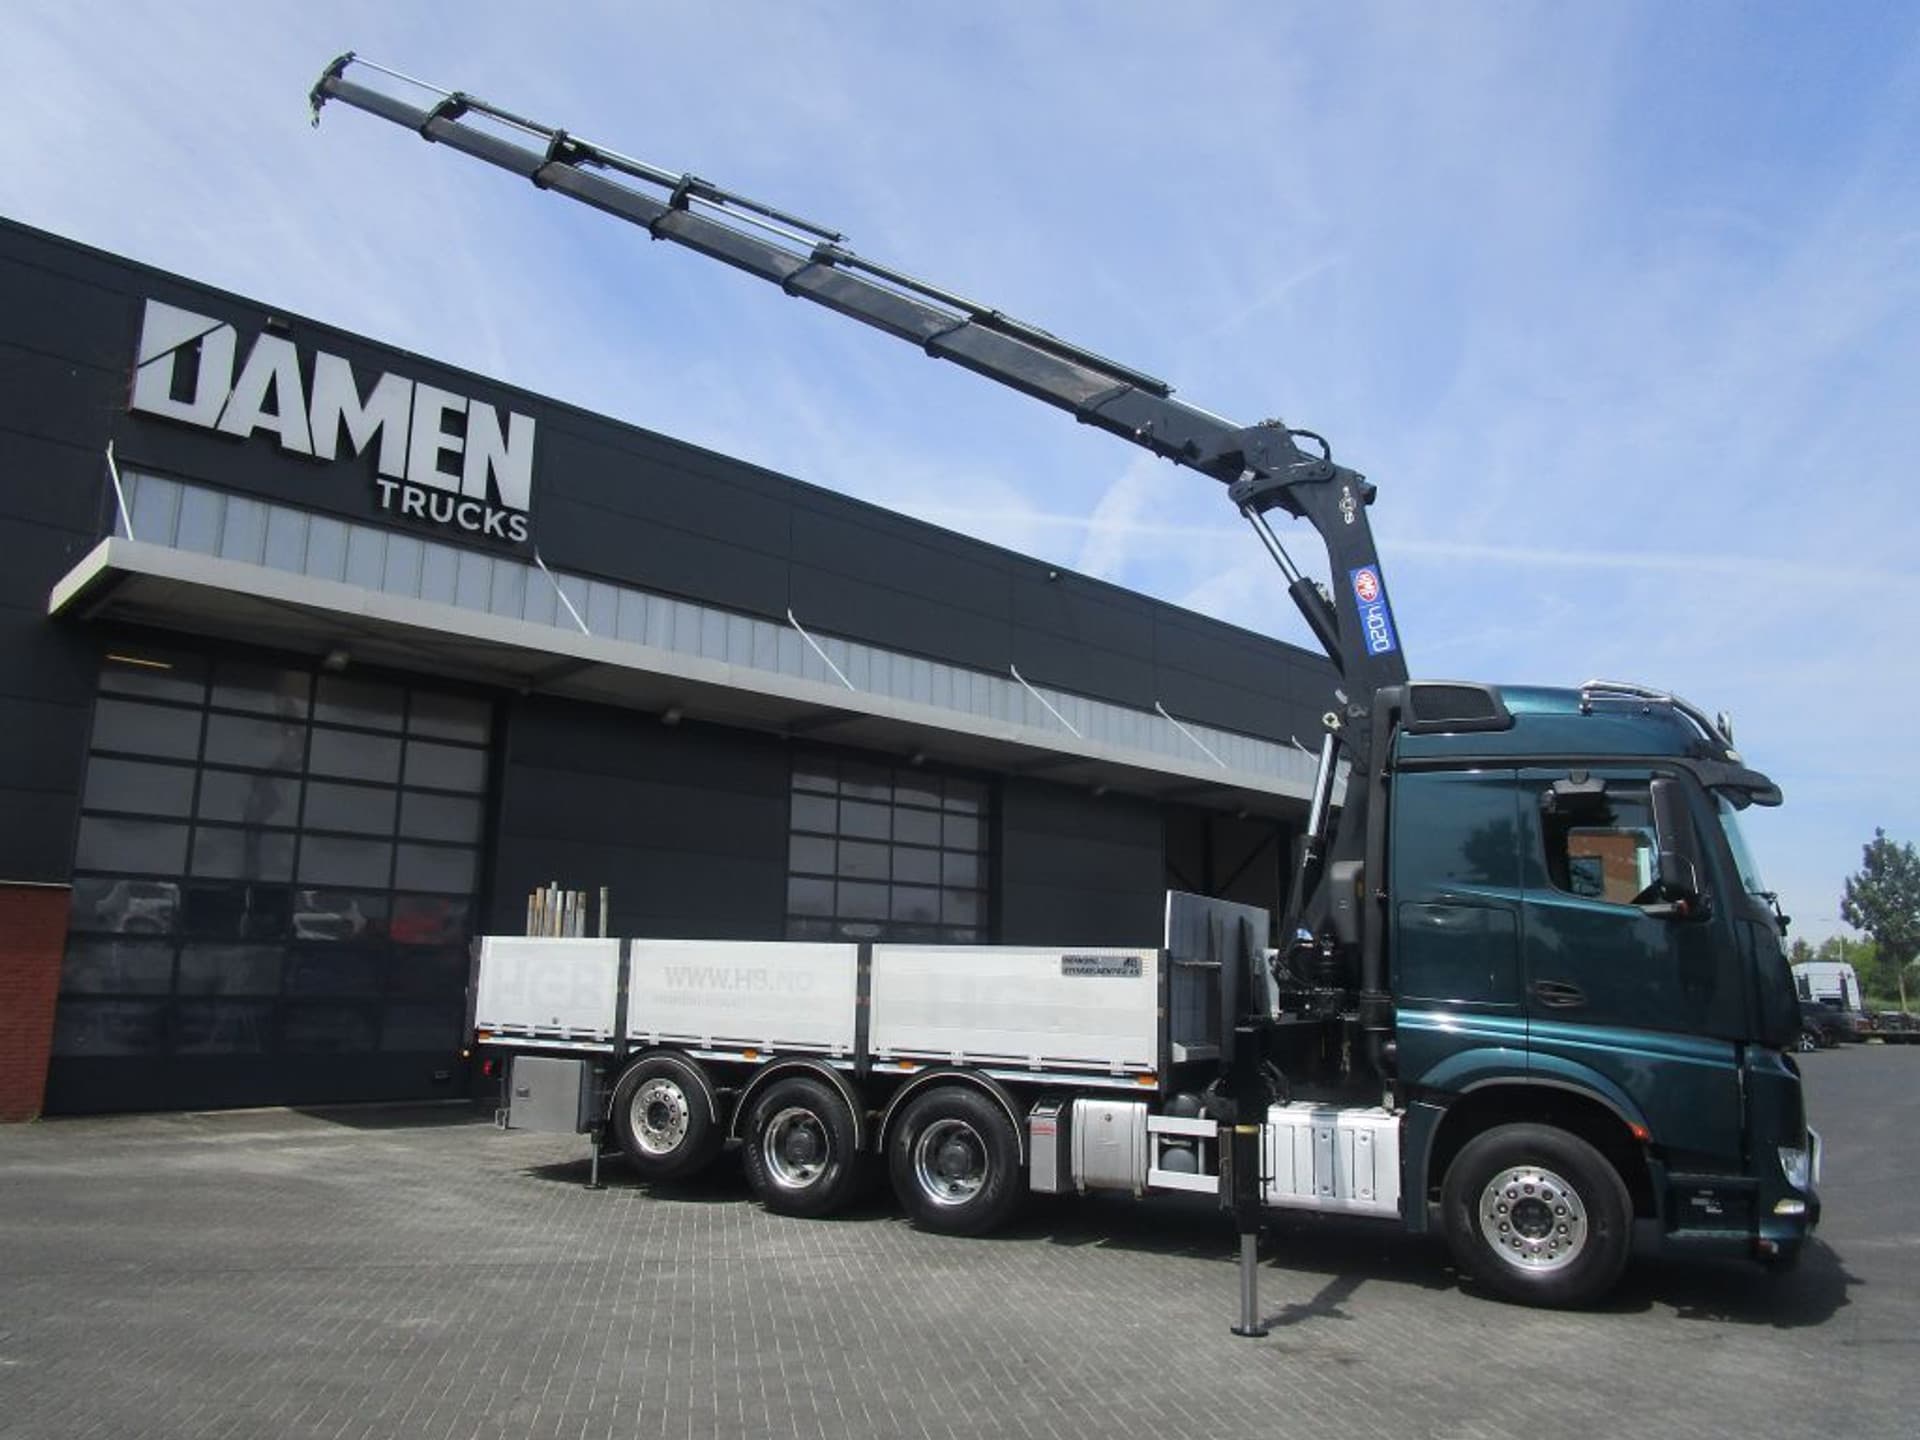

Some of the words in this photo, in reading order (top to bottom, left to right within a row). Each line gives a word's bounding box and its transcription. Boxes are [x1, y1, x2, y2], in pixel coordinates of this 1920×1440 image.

[131, 298, 536, 511] DAMEN
[376, 478, 530, 542] TRUCKS
[1367, 605, 1391, 653] 4020
